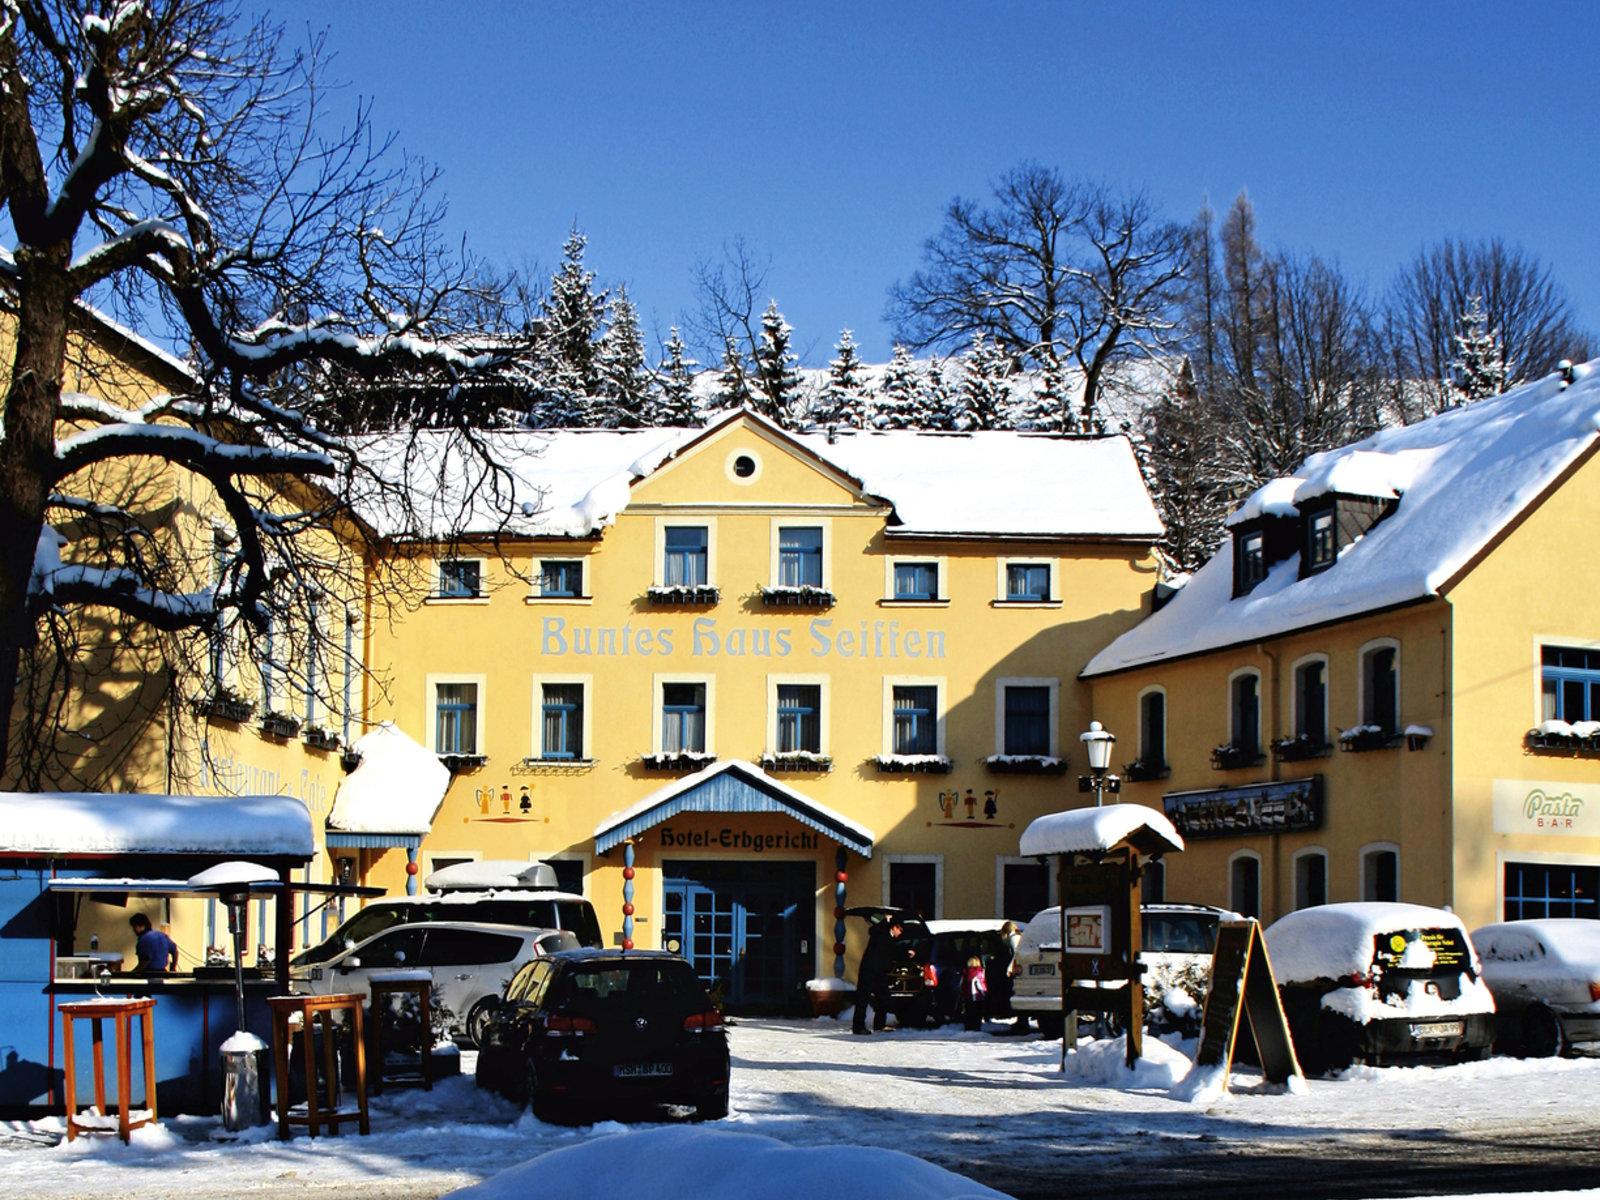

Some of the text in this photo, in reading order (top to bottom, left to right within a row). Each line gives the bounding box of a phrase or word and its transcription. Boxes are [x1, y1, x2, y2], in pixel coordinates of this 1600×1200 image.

[541, 616, 947, 658] Buntes Haus Seiffen
[1526, 793, 1581, 819] Pasta
[660, 828, 819, 852] Hotel-Erbgericht
